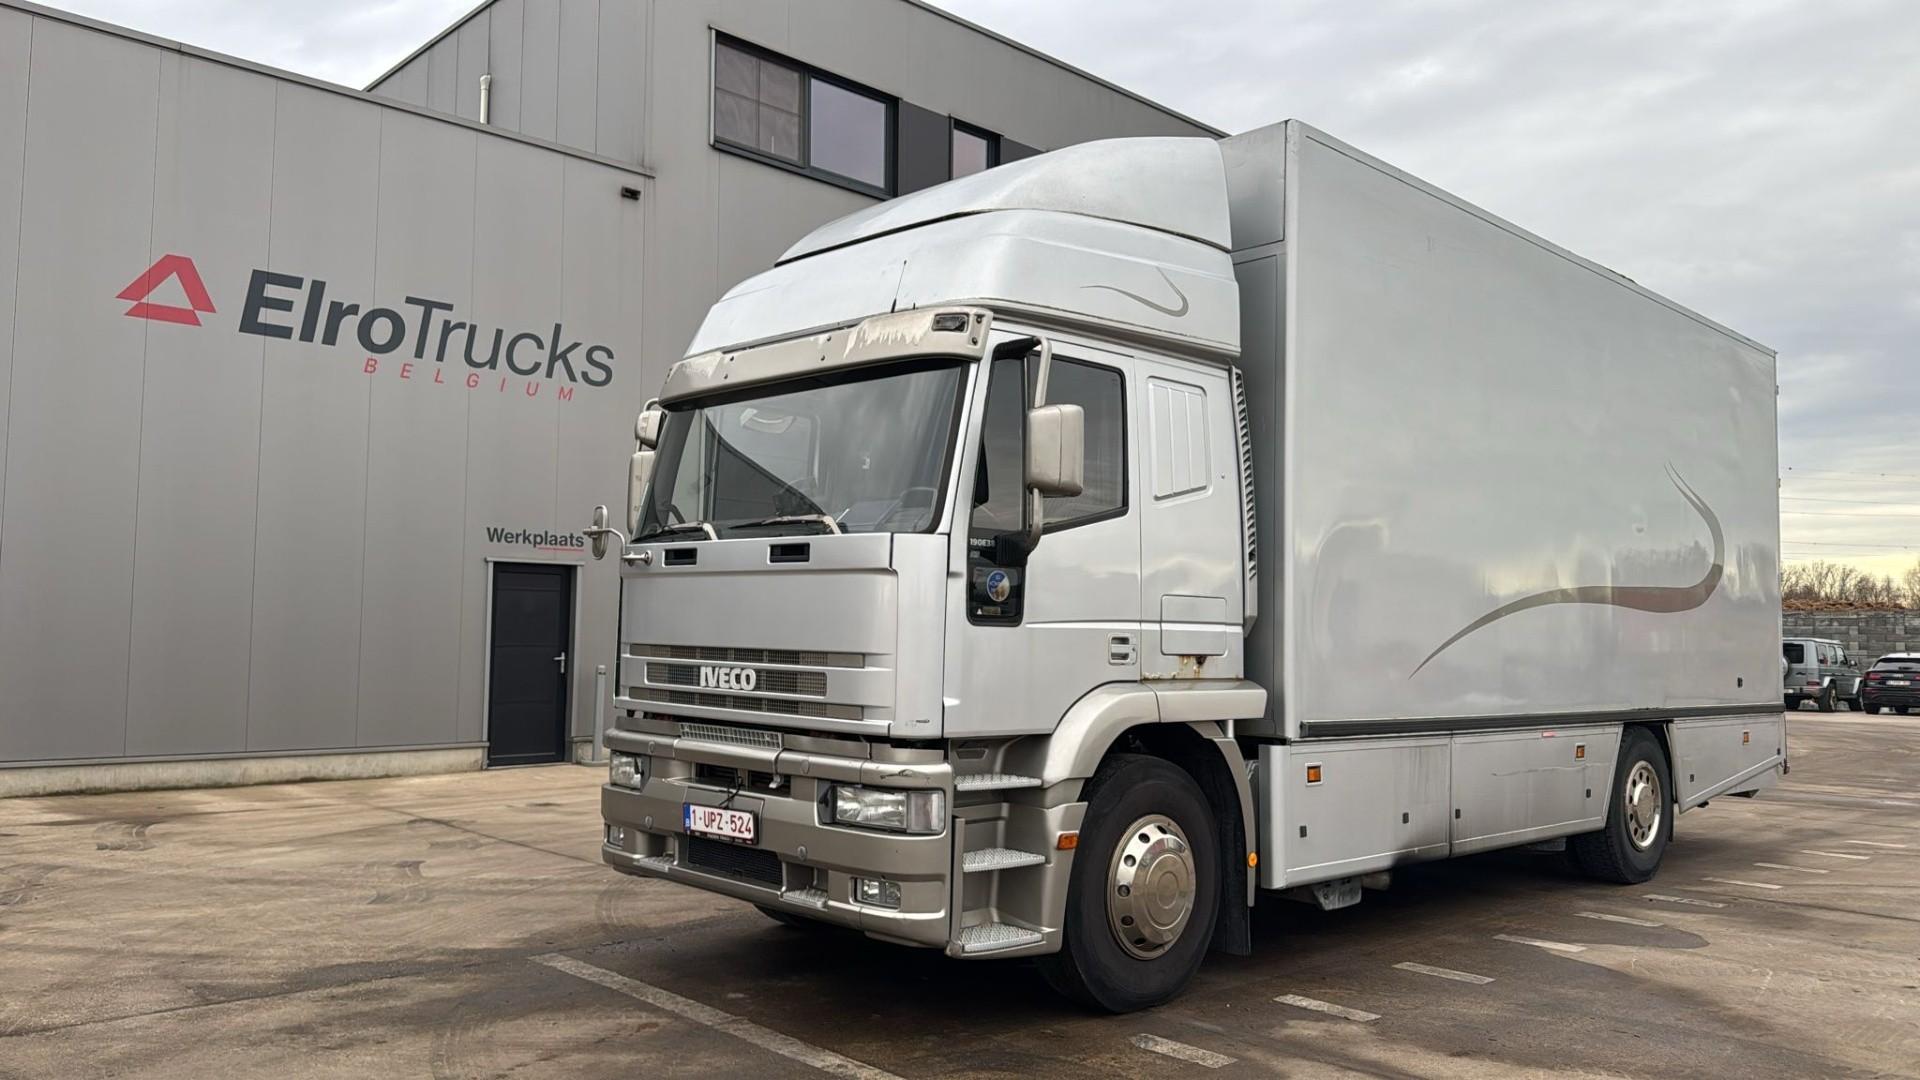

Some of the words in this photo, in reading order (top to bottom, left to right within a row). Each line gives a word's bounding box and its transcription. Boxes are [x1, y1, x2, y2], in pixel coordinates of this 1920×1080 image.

[238, 269, 614, 387] ElroTrucks
[363, 357, 574, 401] BELGIUM
[486, 527, 584, 548] Werkplaats
[700, 666, 756, 690] IVECO
[691, 808, 752, 835] 1-UPZ-524
